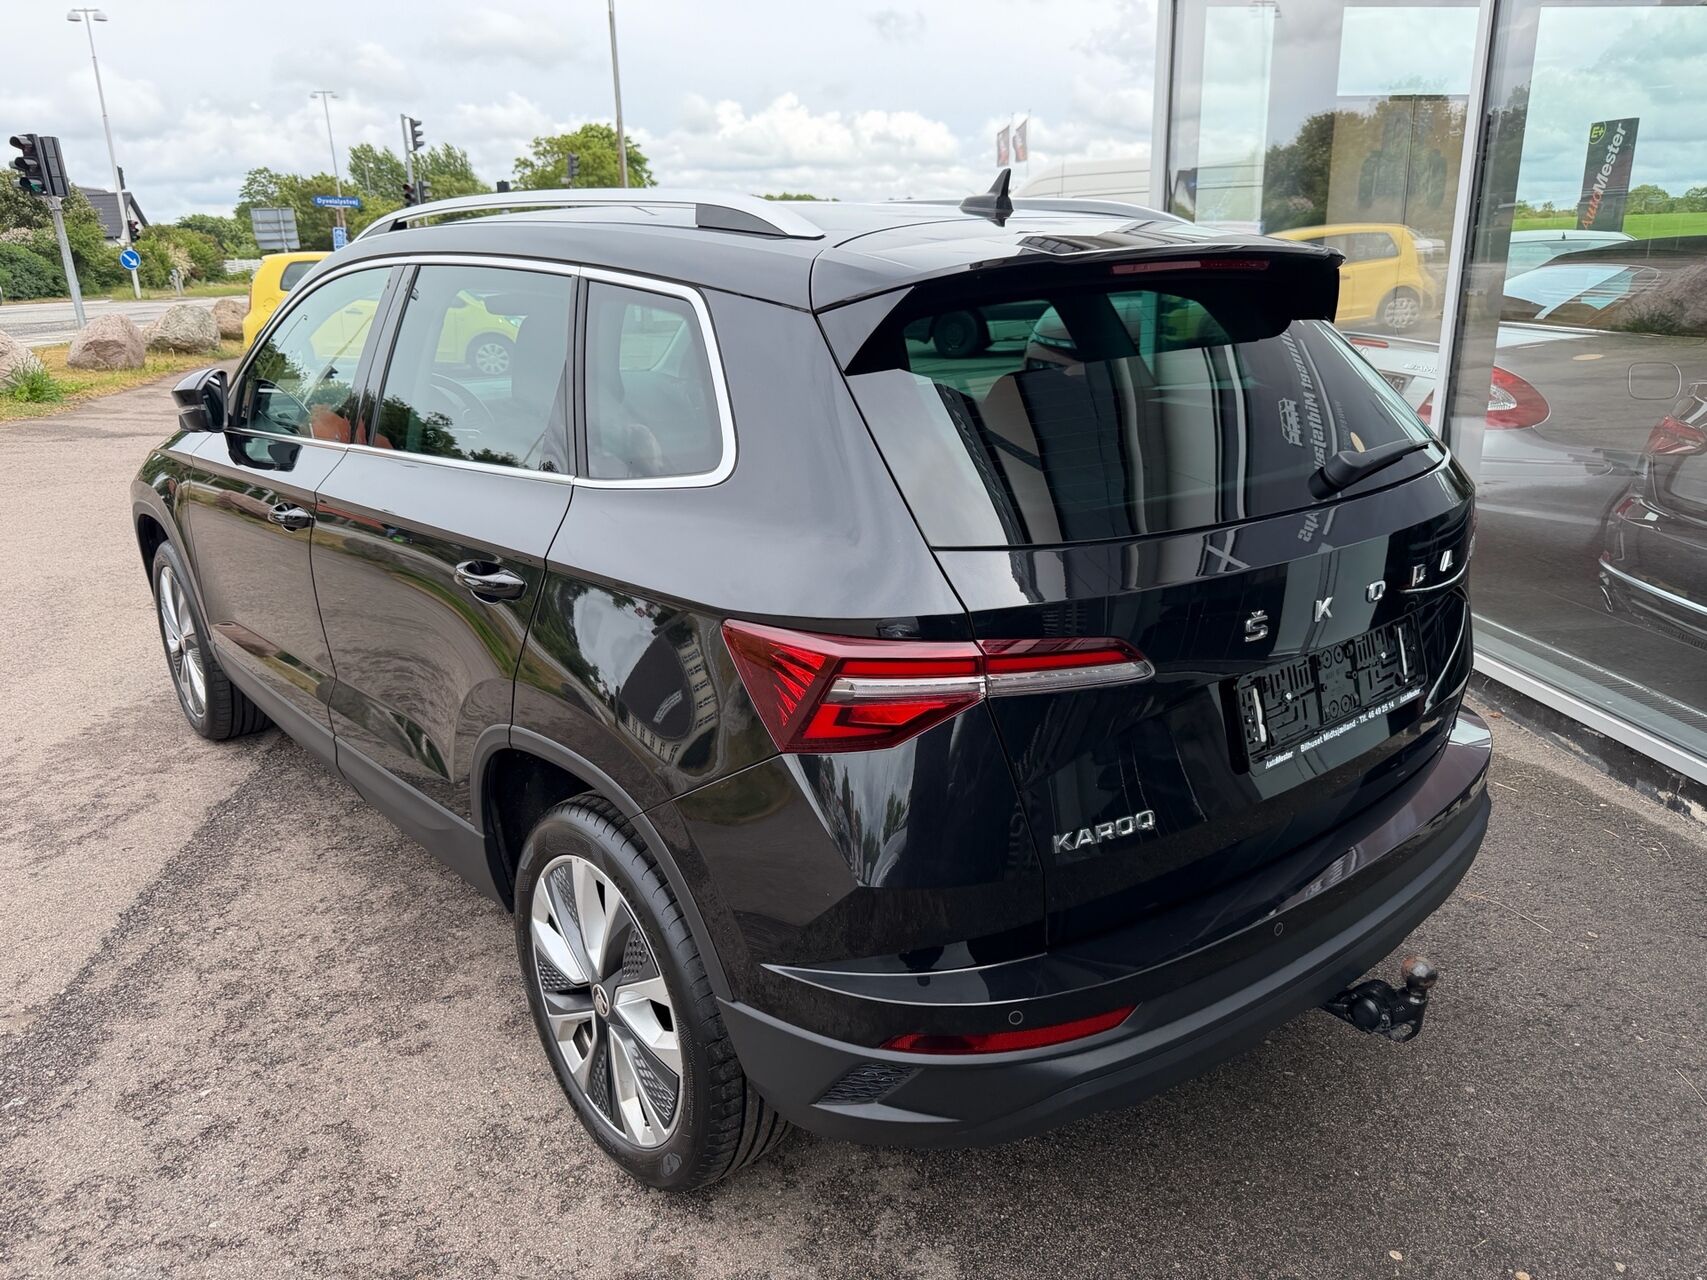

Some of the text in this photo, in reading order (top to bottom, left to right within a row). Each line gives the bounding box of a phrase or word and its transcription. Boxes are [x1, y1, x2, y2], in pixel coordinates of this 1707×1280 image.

[1582, 123, 1627, 229] AutoMester
[1245, 549, 1454, 642] ŠKODA
[1300, 736, 1323, 752] Bilhuset
[1323, 720, 1356, 741] Midtsjælland
[1053, 810, 1156, 854] KAROQ
